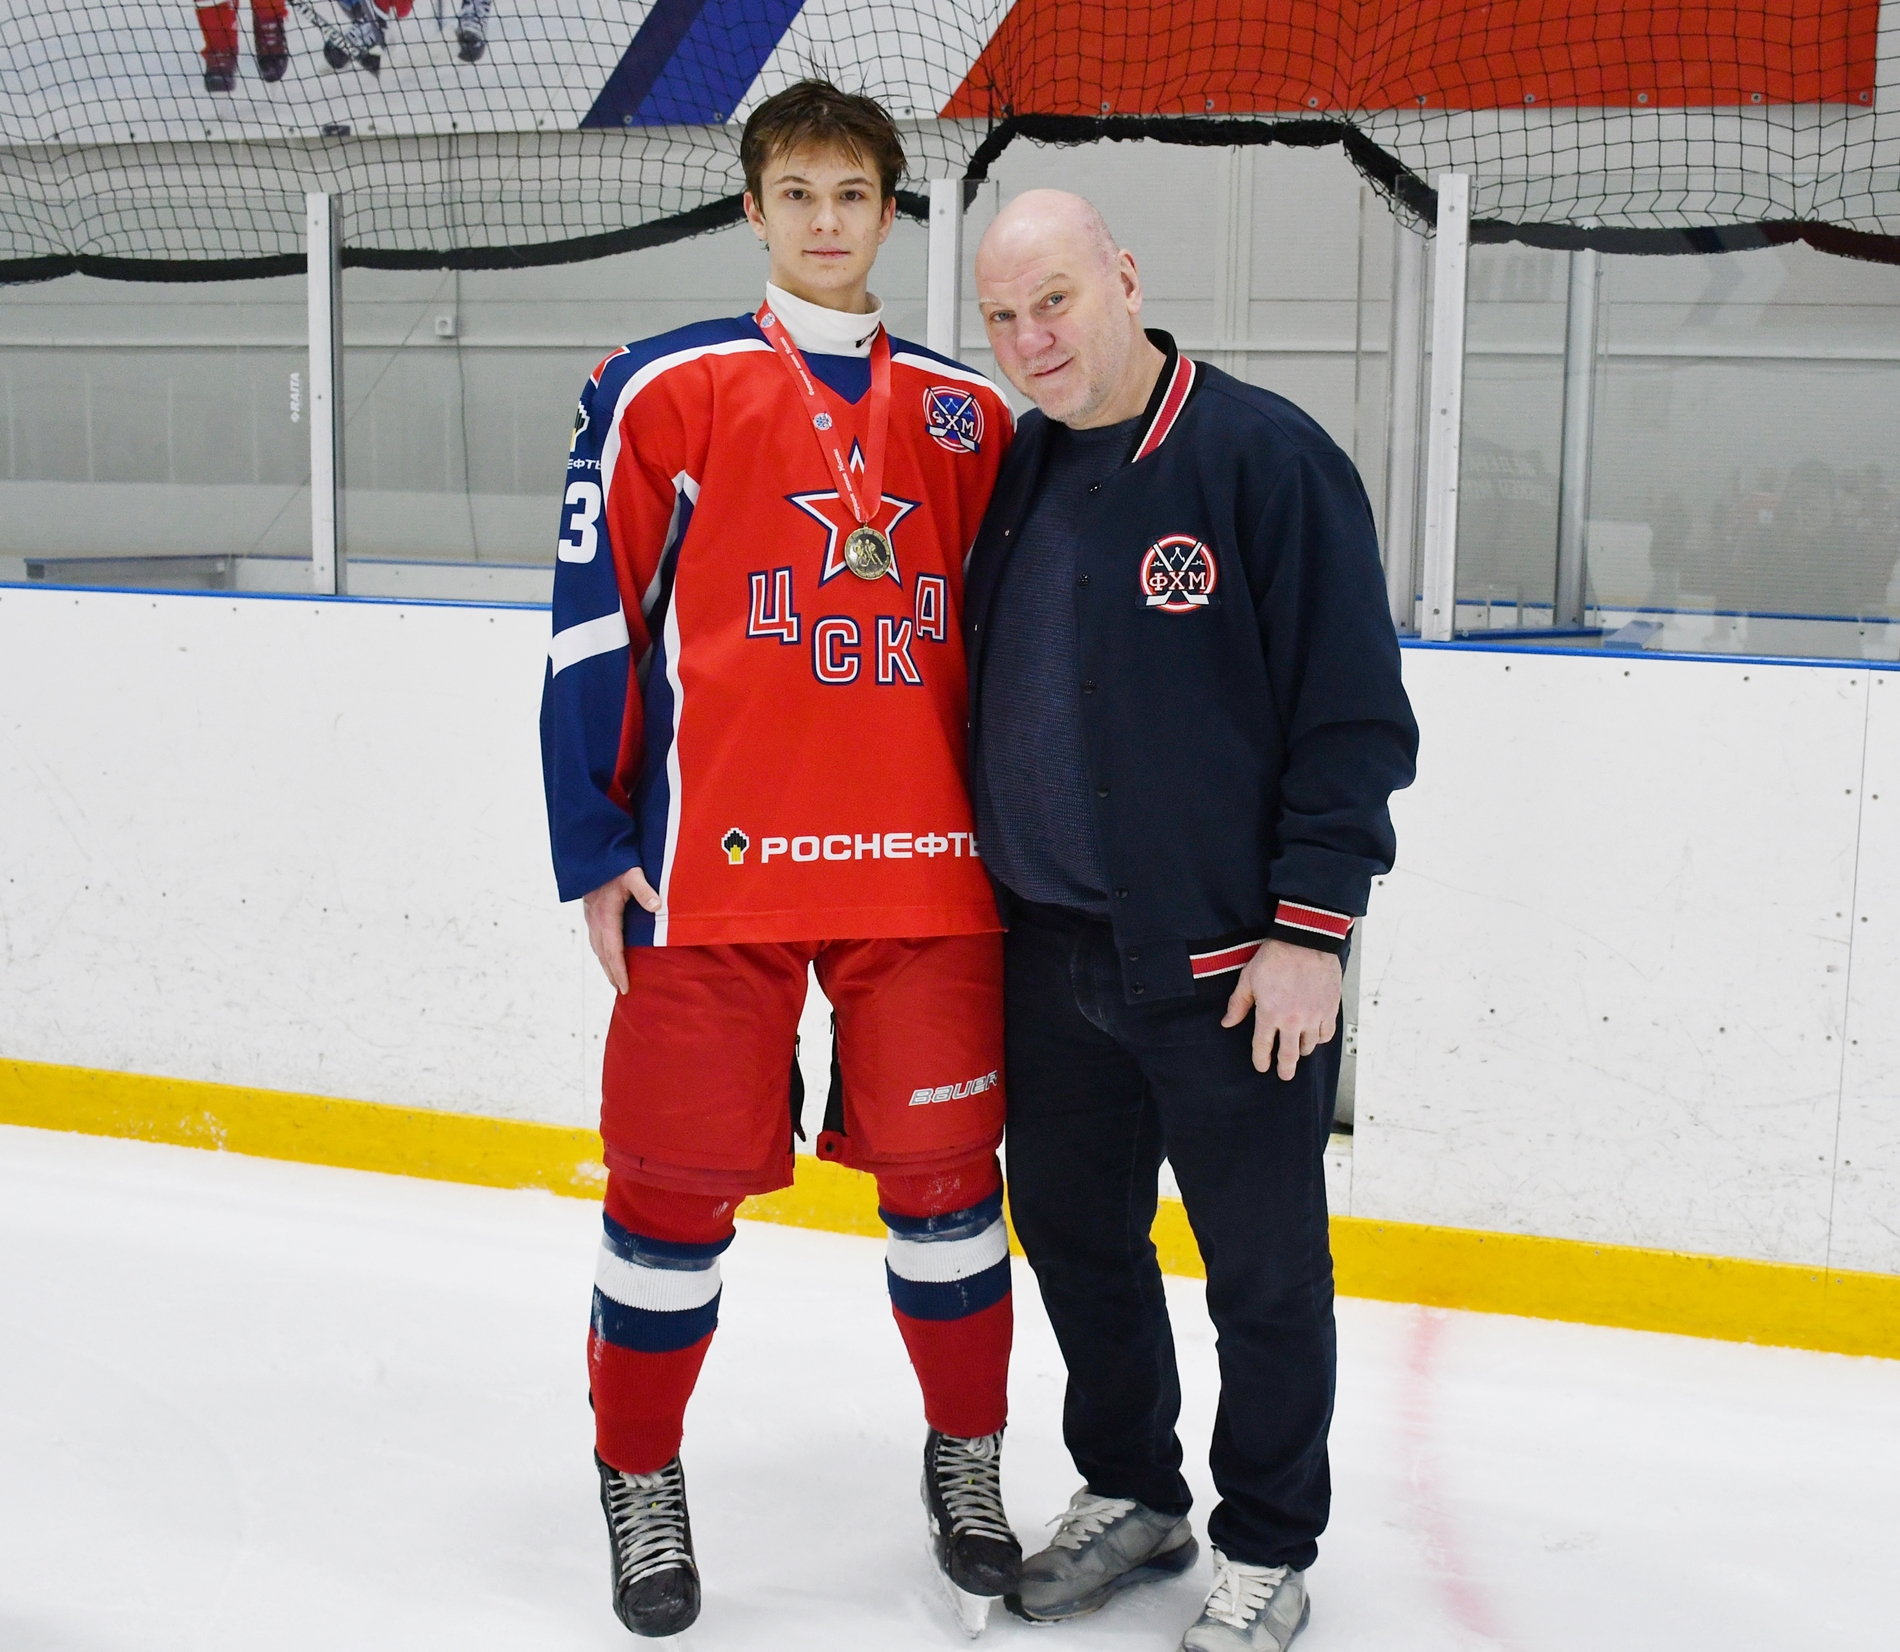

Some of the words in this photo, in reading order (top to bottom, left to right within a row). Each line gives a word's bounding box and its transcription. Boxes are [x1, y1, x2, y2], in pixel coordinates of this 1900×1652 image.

[558, 481, 601, 564] 3
[1149, 571, 1206, 591] ФХМ
[746, 566, 947, 686] ЦСКА
